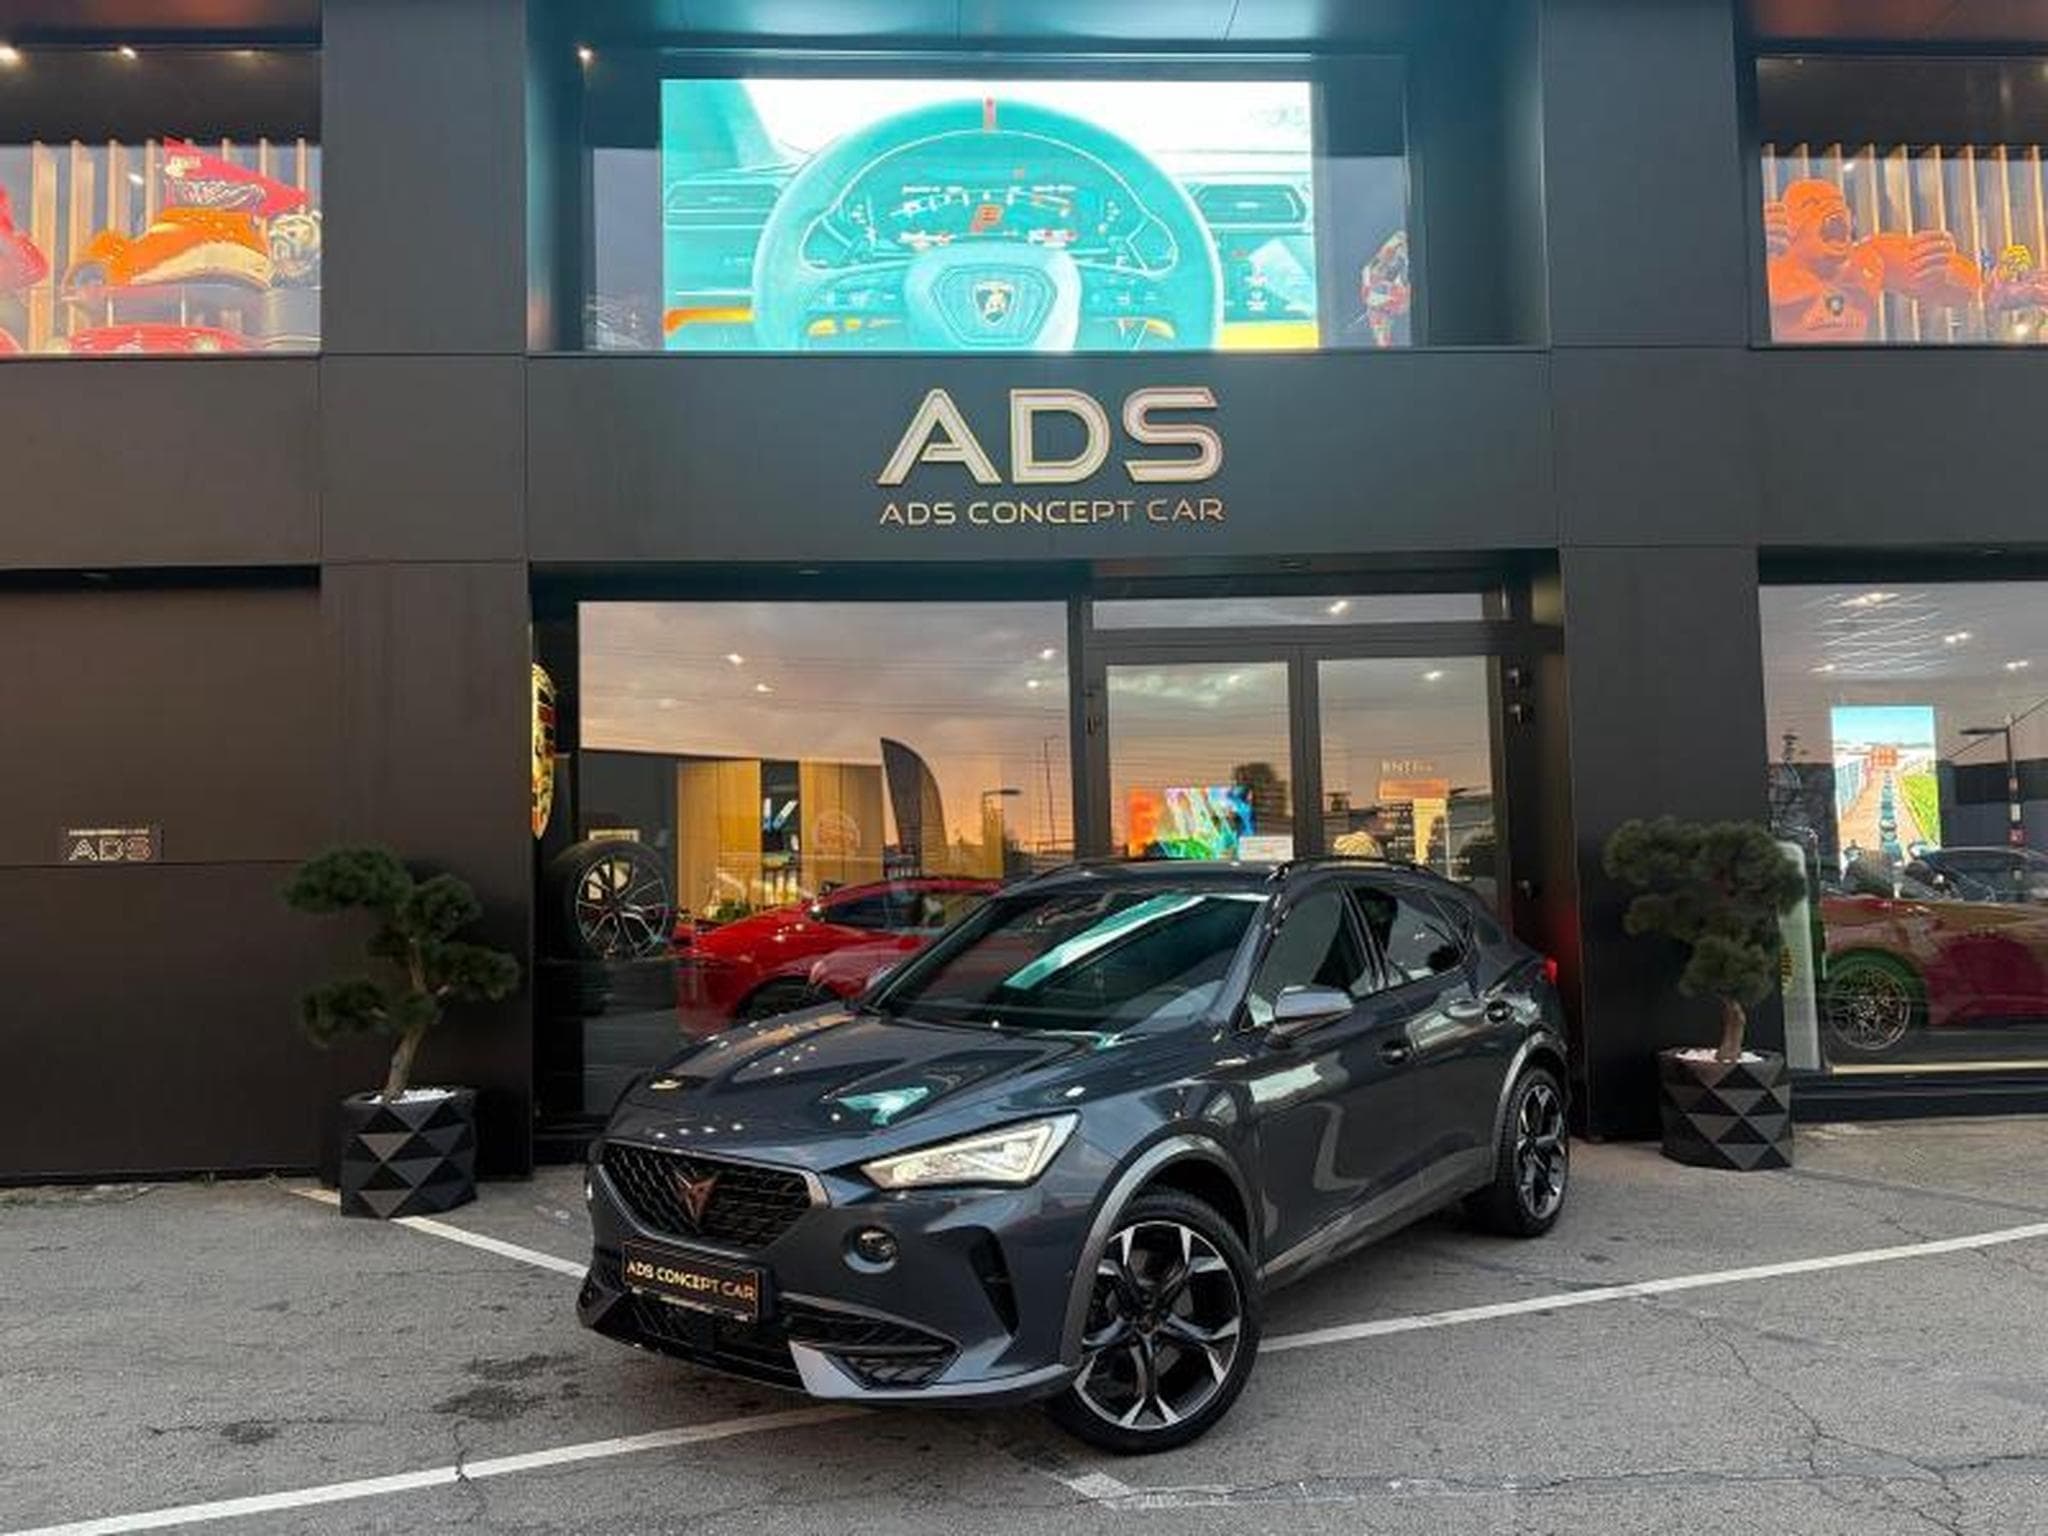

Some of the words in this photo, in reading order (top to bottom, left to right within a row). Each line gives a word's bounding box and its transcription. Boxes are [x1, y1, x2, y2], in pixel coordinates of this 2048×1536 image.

[877, 387, 1222, 485] ADS
[879, 502, 956, 526] ADS
[968, 500, 1134, 525] CONCEPT
[1146, 498, 1225, 522] CAR
[68, 838, 152, 861] ADS
[626, 1260, 654, 1279] ADS
[656, 1267, 720, 1292] CONCEPT
[720, 1280, 756, 1301] CAR
